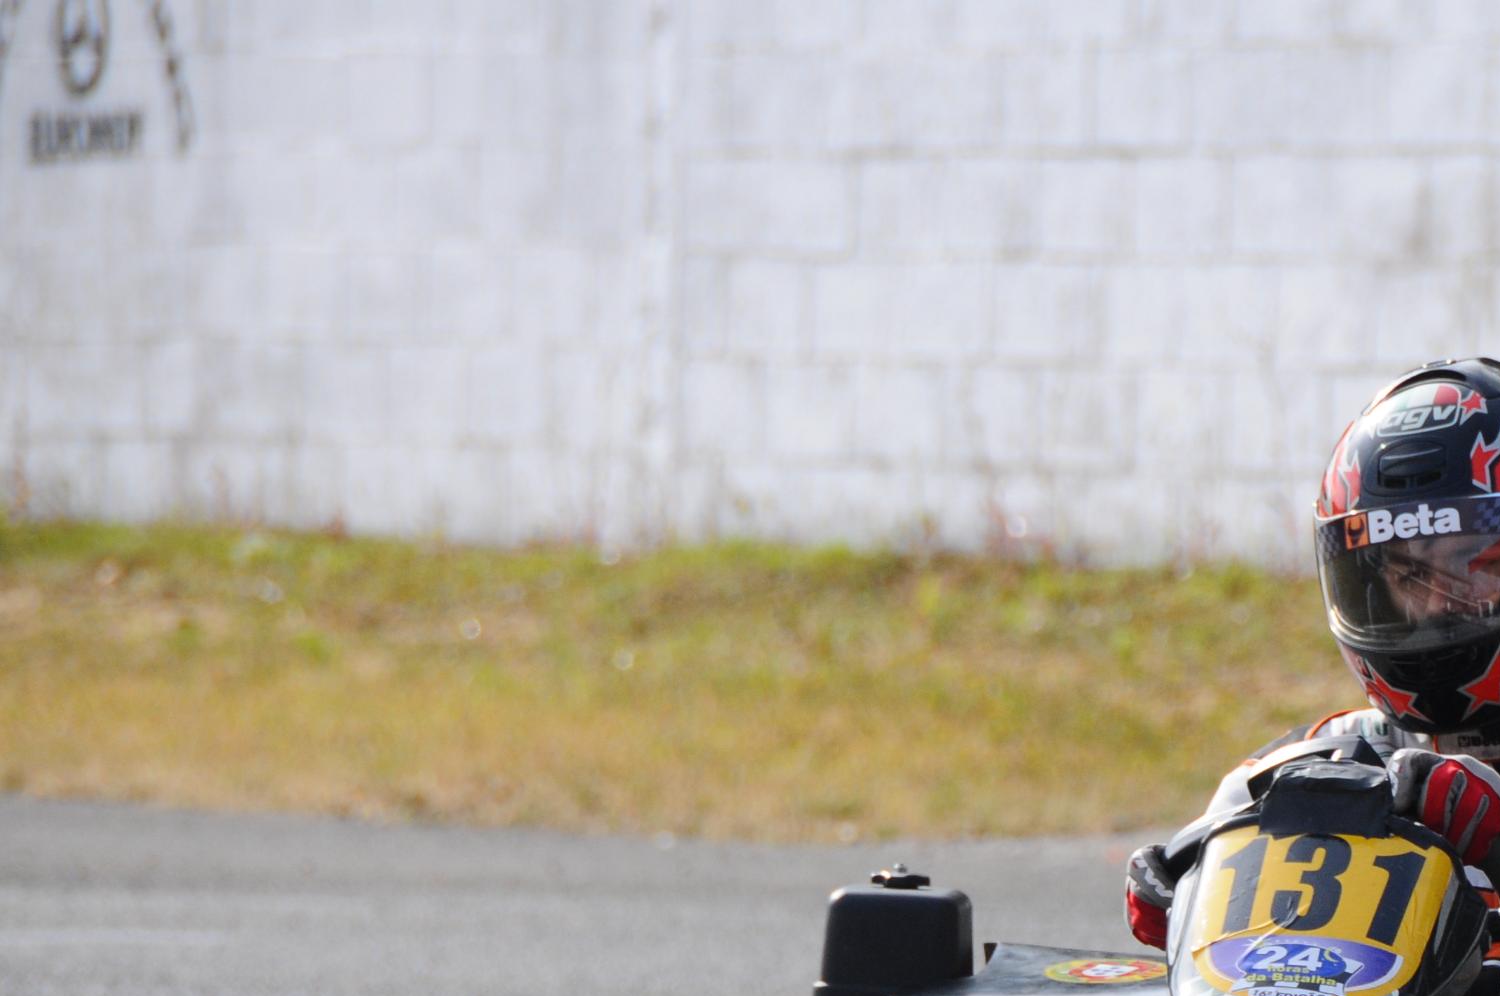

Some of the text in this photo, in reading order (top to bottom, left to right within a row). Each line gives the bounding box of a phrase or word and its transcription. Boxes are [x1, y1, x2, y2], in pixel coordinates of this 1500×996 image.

[1380, 405, 1456, 431] agv
[1367, 503, 1461, 544] Beta
[1219, 834, 1426, 947] 131
[1253, 945, 1322, 971] 24
[1267, 964, 1311, 974] horas
[1247, 973, 1337, 986] da Batalha
